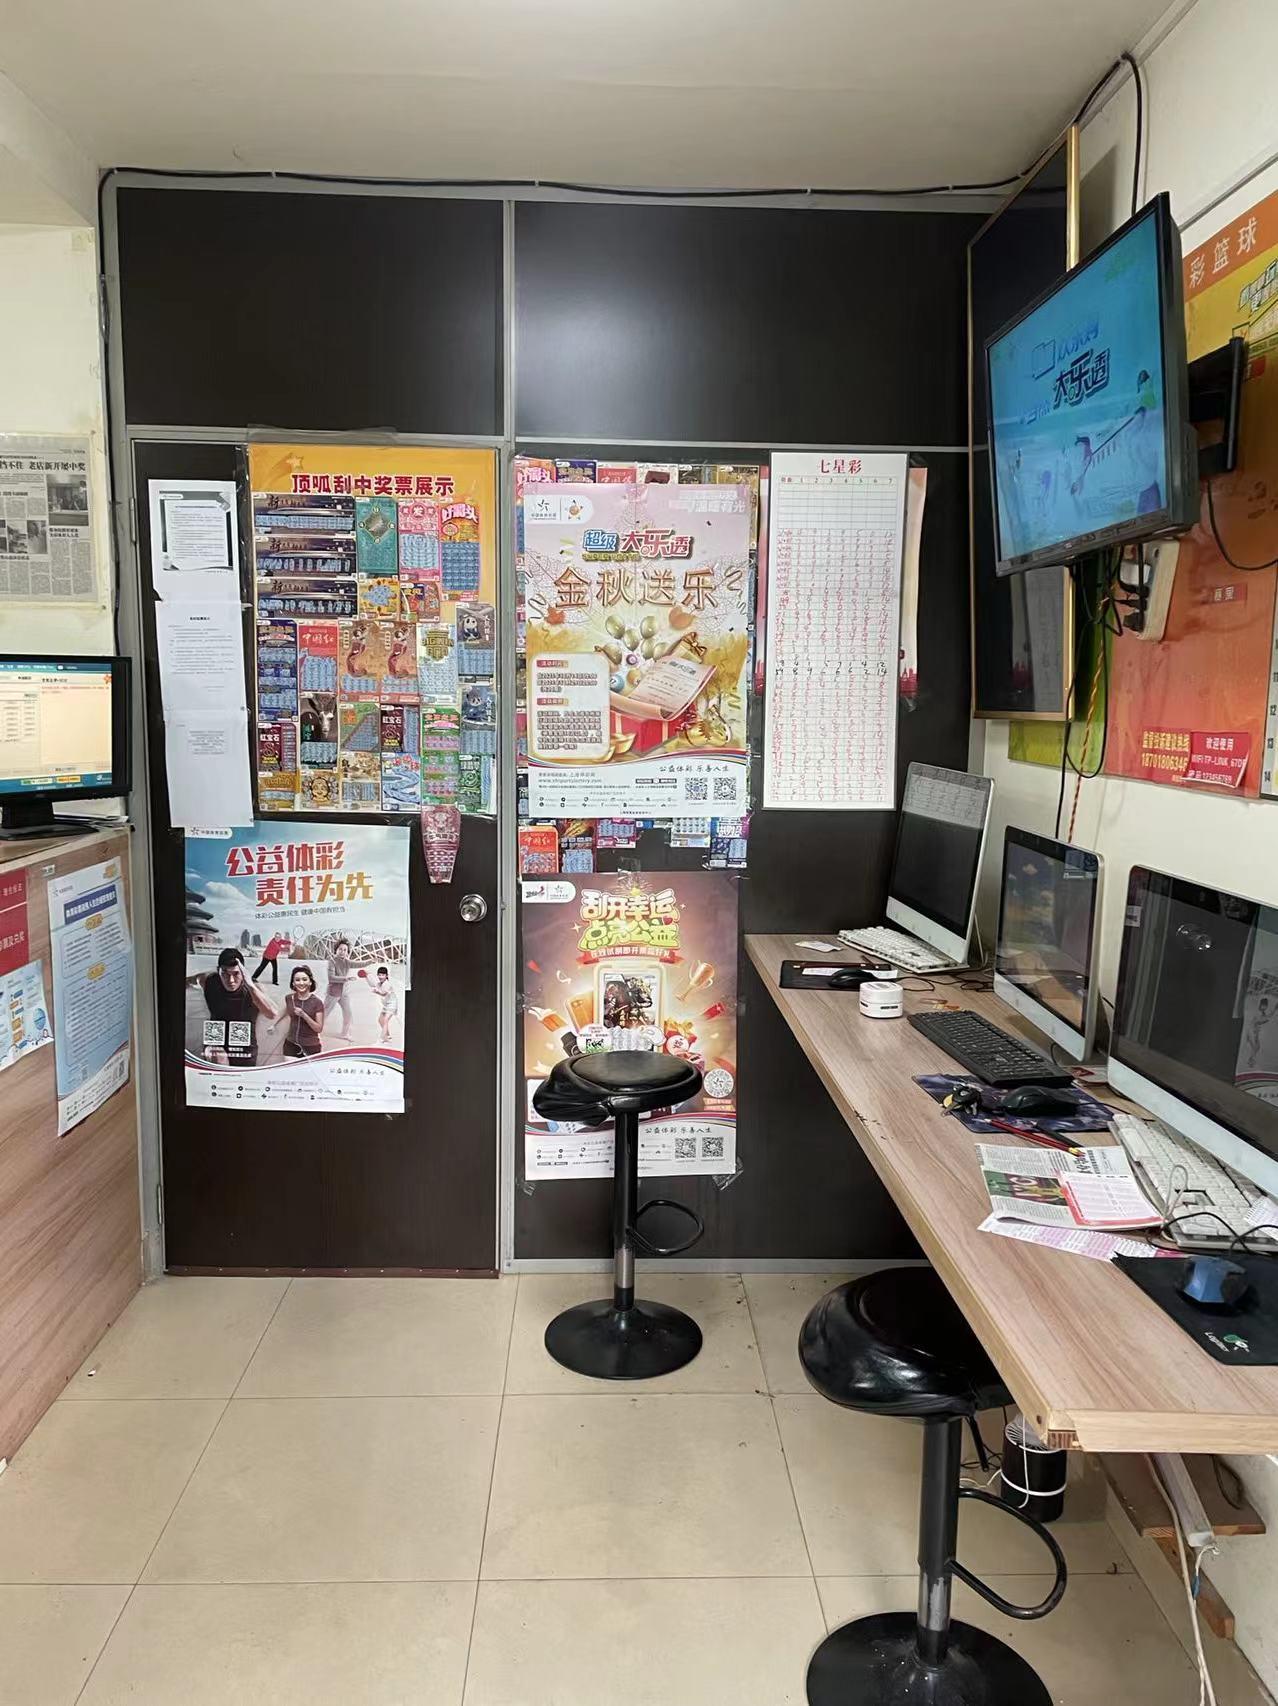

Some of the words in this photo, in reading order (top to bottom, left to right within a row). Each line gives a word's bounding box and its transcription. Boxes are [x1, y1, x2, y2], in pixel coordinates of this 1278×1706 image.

[820, 458, 862, 474] 七星彩
[291, 473, 454, 496] 顶呱刮中奖票展示
[583, 528, 692, 558] 超级大乐透
[553, 565, 719, 610] 金秋送乐
[383, 716, 401, 724] 红宝石
[260, 734, 280, 742] 红宝石
[1206, 737, 1234, 751] 欢迎使用
[226, 841, 345, 877] 公益体彩
[256, 872, 374, 907] 责任为先
[581, 888, 681, 920] 刮开幸运
[580, 918, 680, 950] 点亮公益
